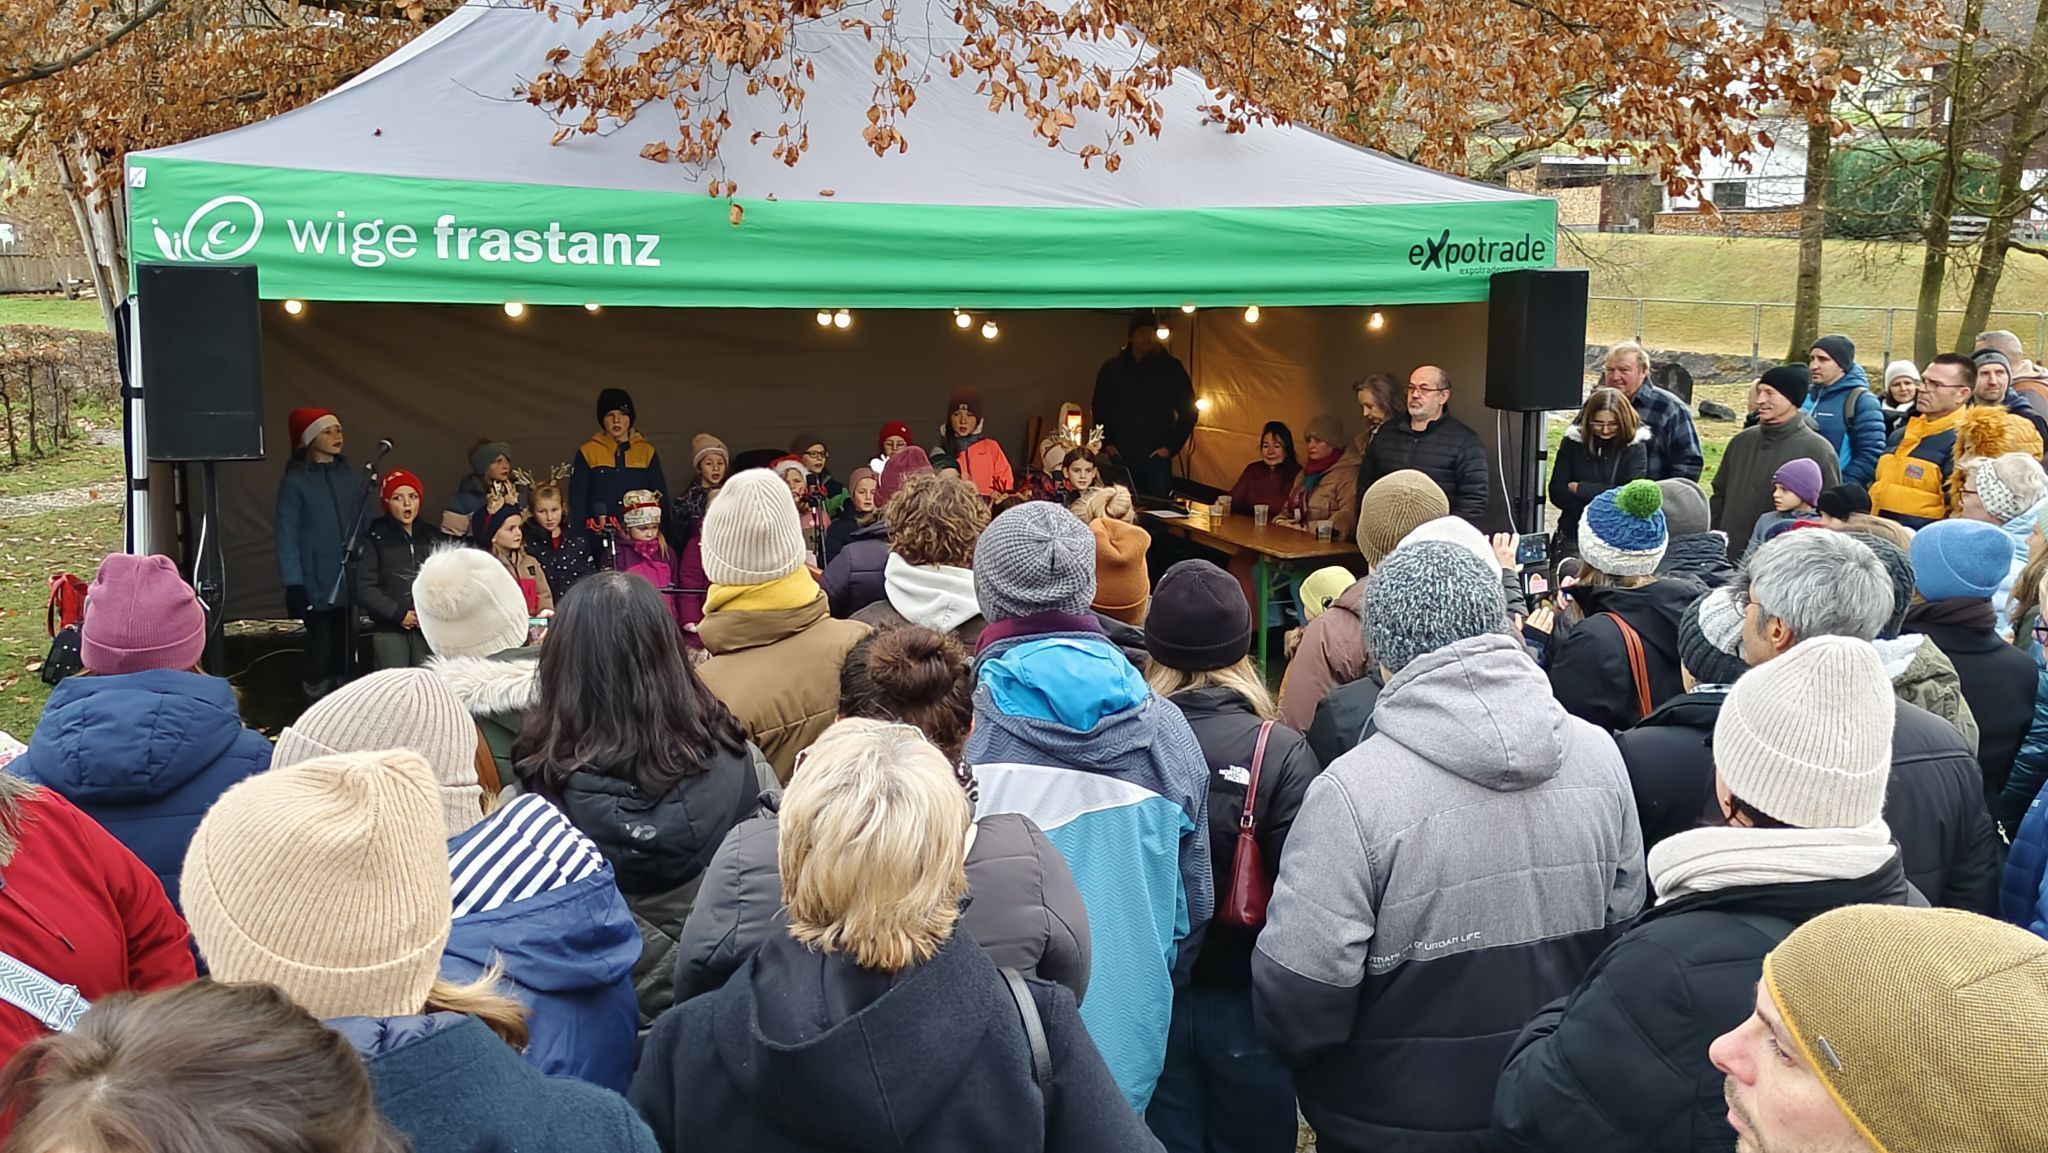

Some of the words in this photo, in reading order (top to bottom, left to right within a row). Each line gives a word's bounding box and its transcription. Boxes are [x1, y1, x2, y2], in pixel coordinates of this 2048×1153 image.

[286, 210, 418, 268] wige
[433, 214, 661, 267] frastanz
[1424, 937, 1459, 951] URBAN
[1460, 931, 1481, 942] LIFE
